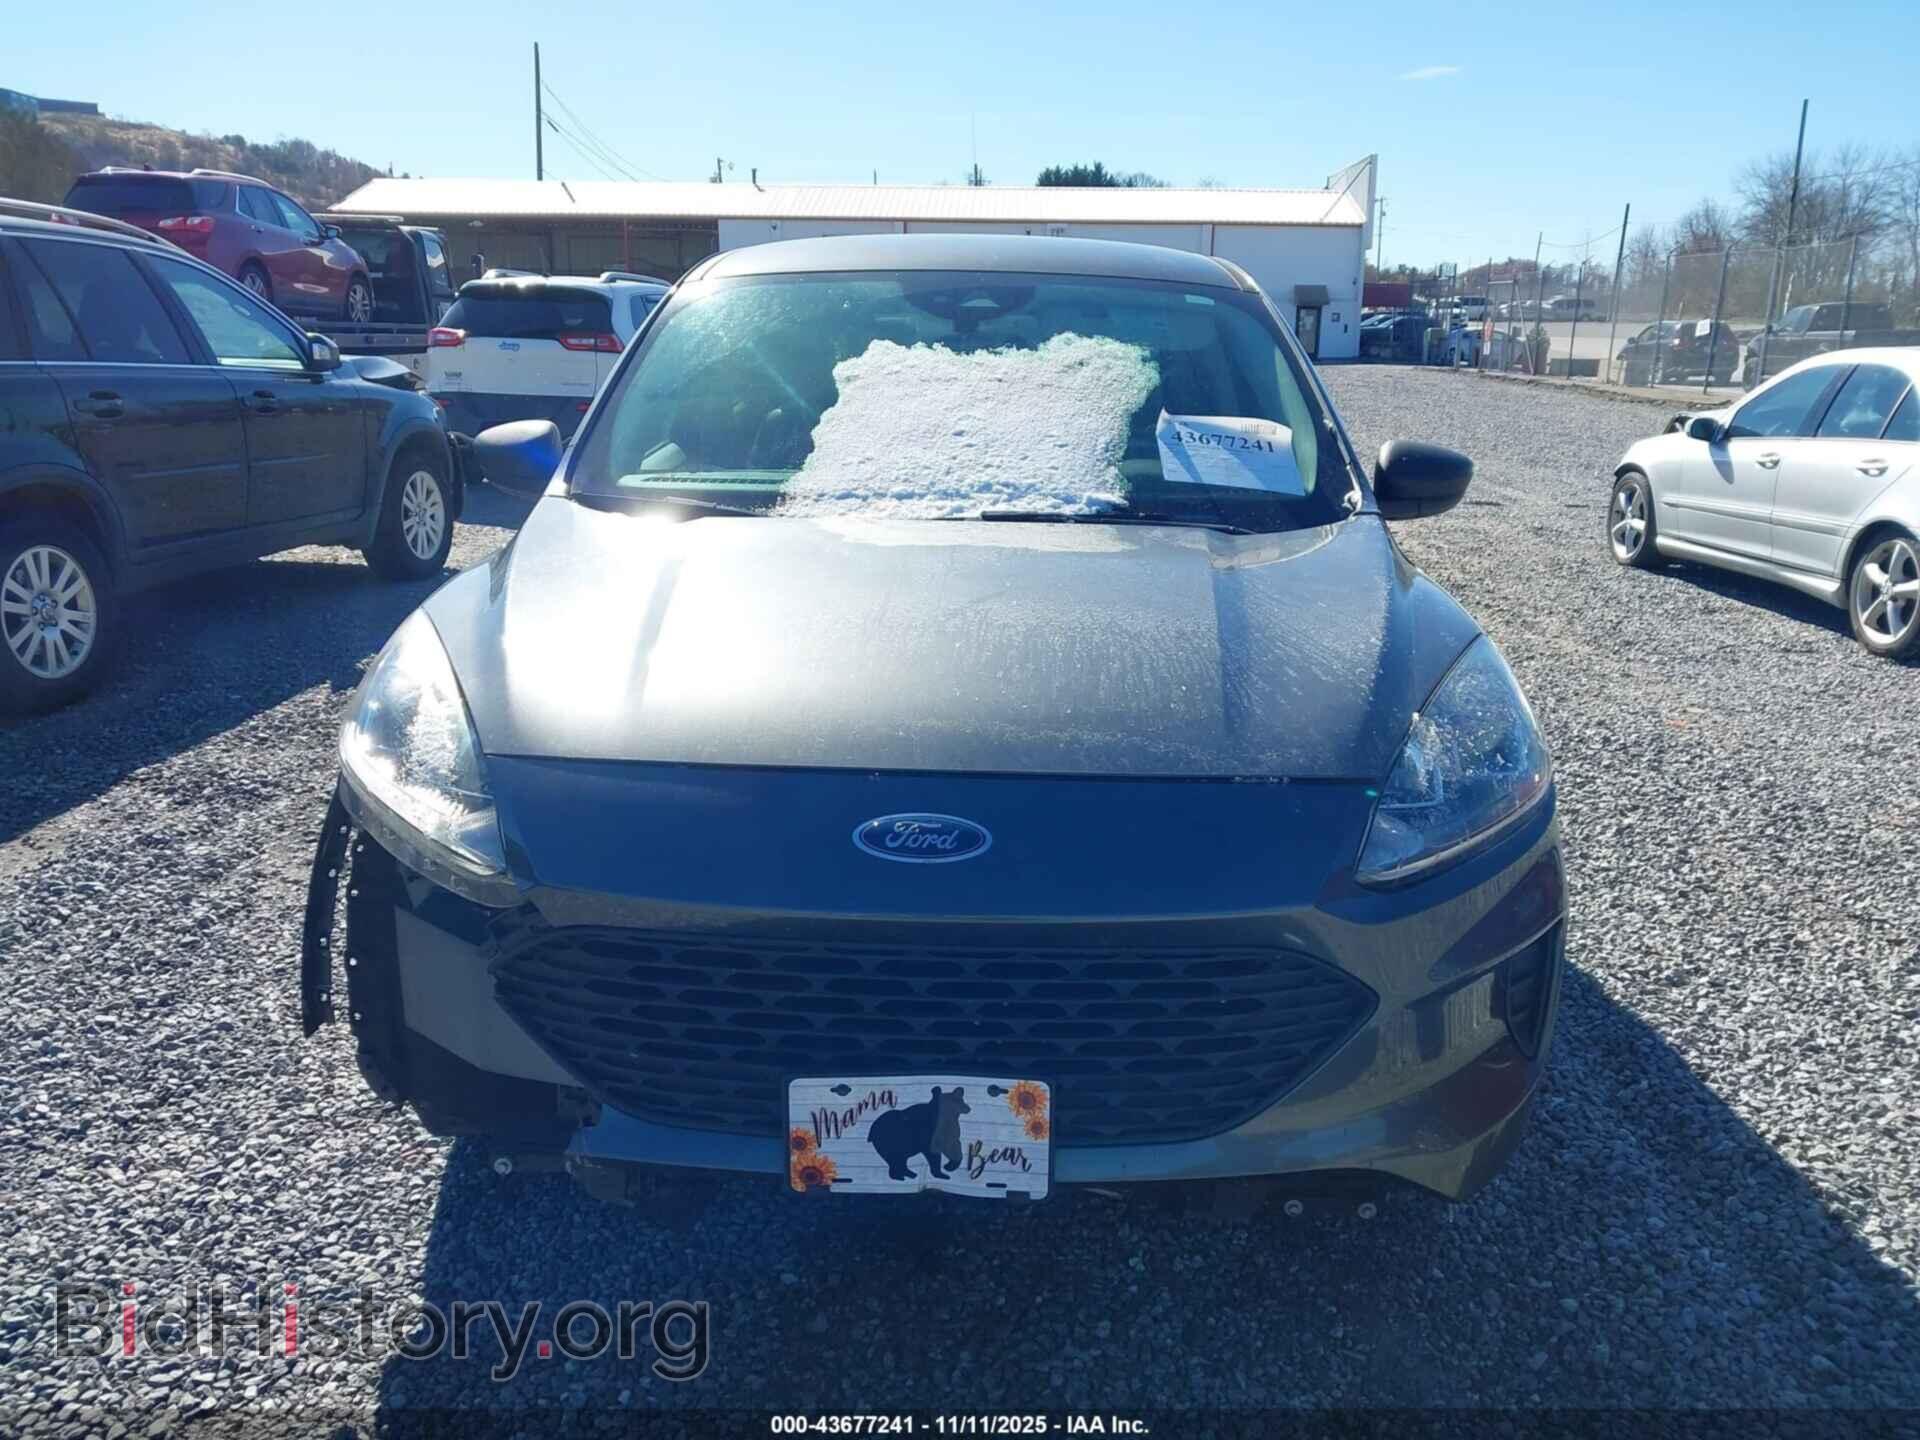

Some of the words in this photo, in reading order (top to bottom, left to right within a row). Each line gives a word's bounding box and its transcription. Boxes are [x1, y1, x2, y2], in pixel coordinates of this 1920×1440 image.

[1170, 431, 1275, 453] 43677241
[885, 821, 959, 849] Ford
[810, 1089, 899, 1149] Mama
[966, 1139, 1033, 1181] Bear
